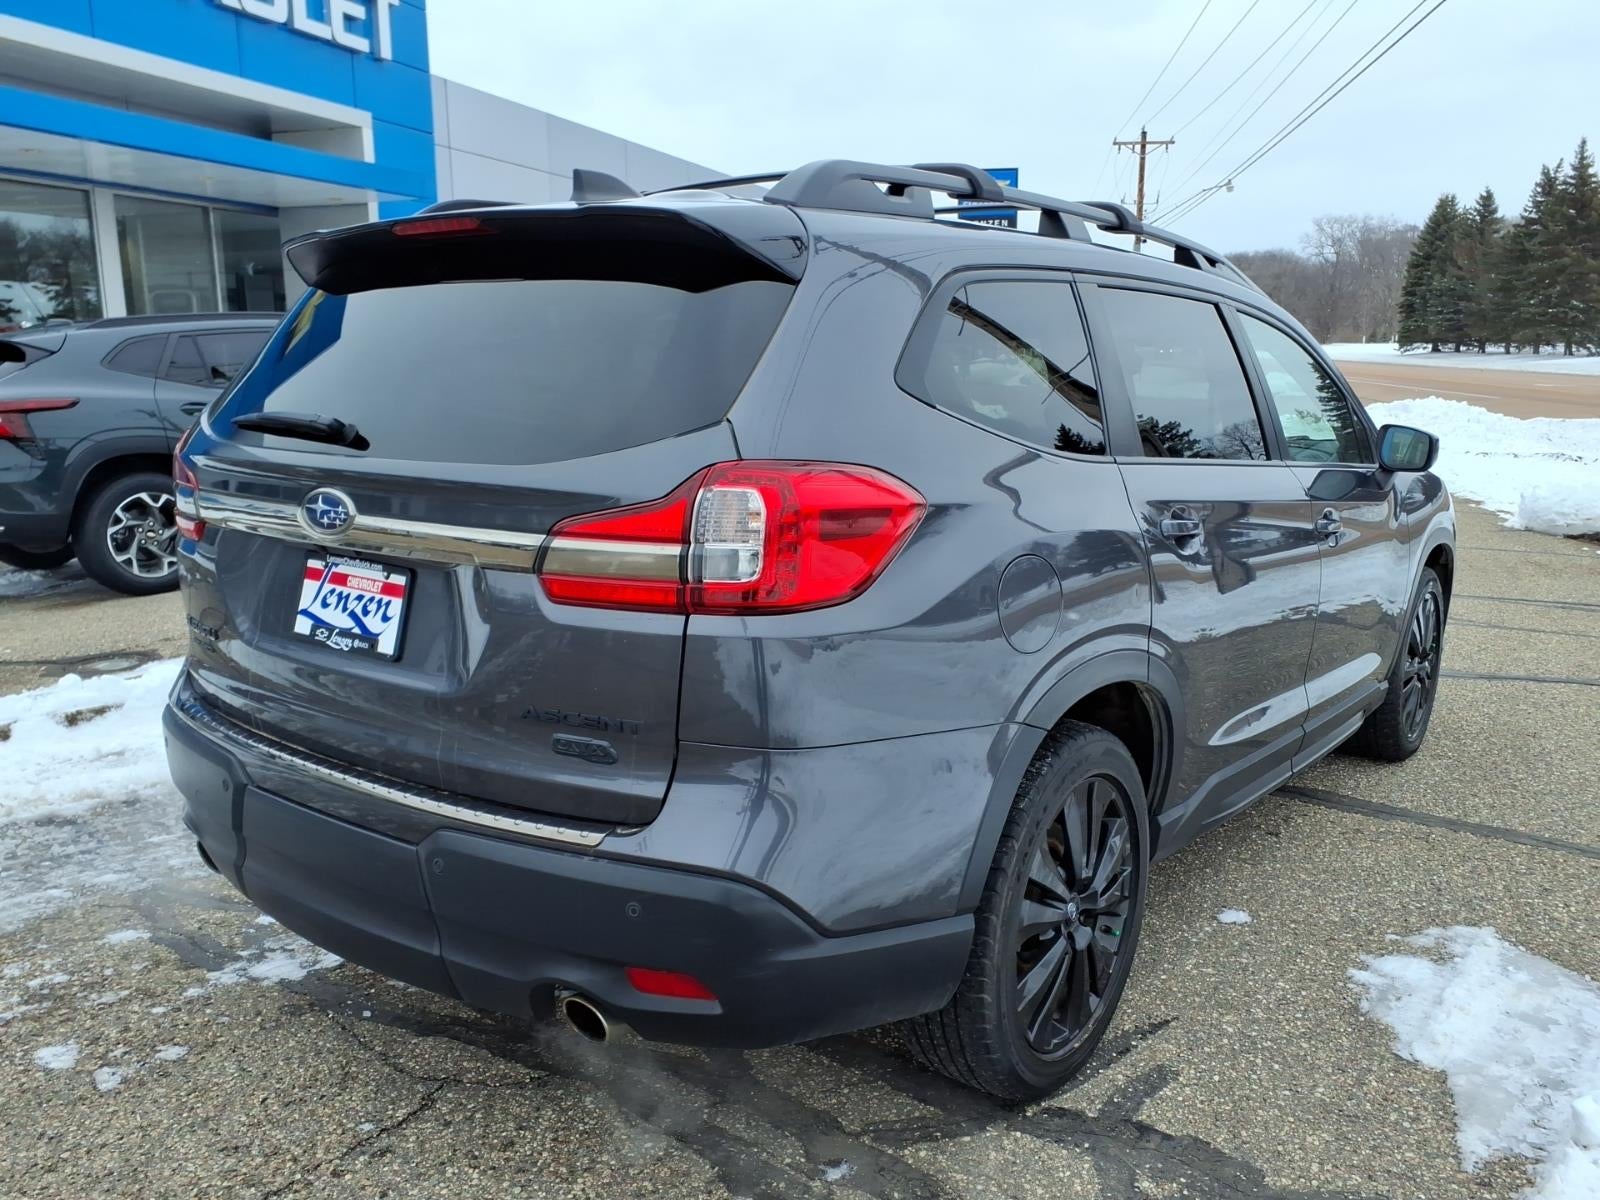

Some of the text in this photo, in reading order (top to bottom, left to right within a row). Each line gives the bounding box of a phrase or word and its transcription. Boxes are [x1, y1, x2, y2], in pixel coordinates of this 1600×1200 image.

[347, 575, 383, 594] CHEVROLET
[297, 562, 397, 639] Lenzen
[520, 704, 645, 735] ASCENT
